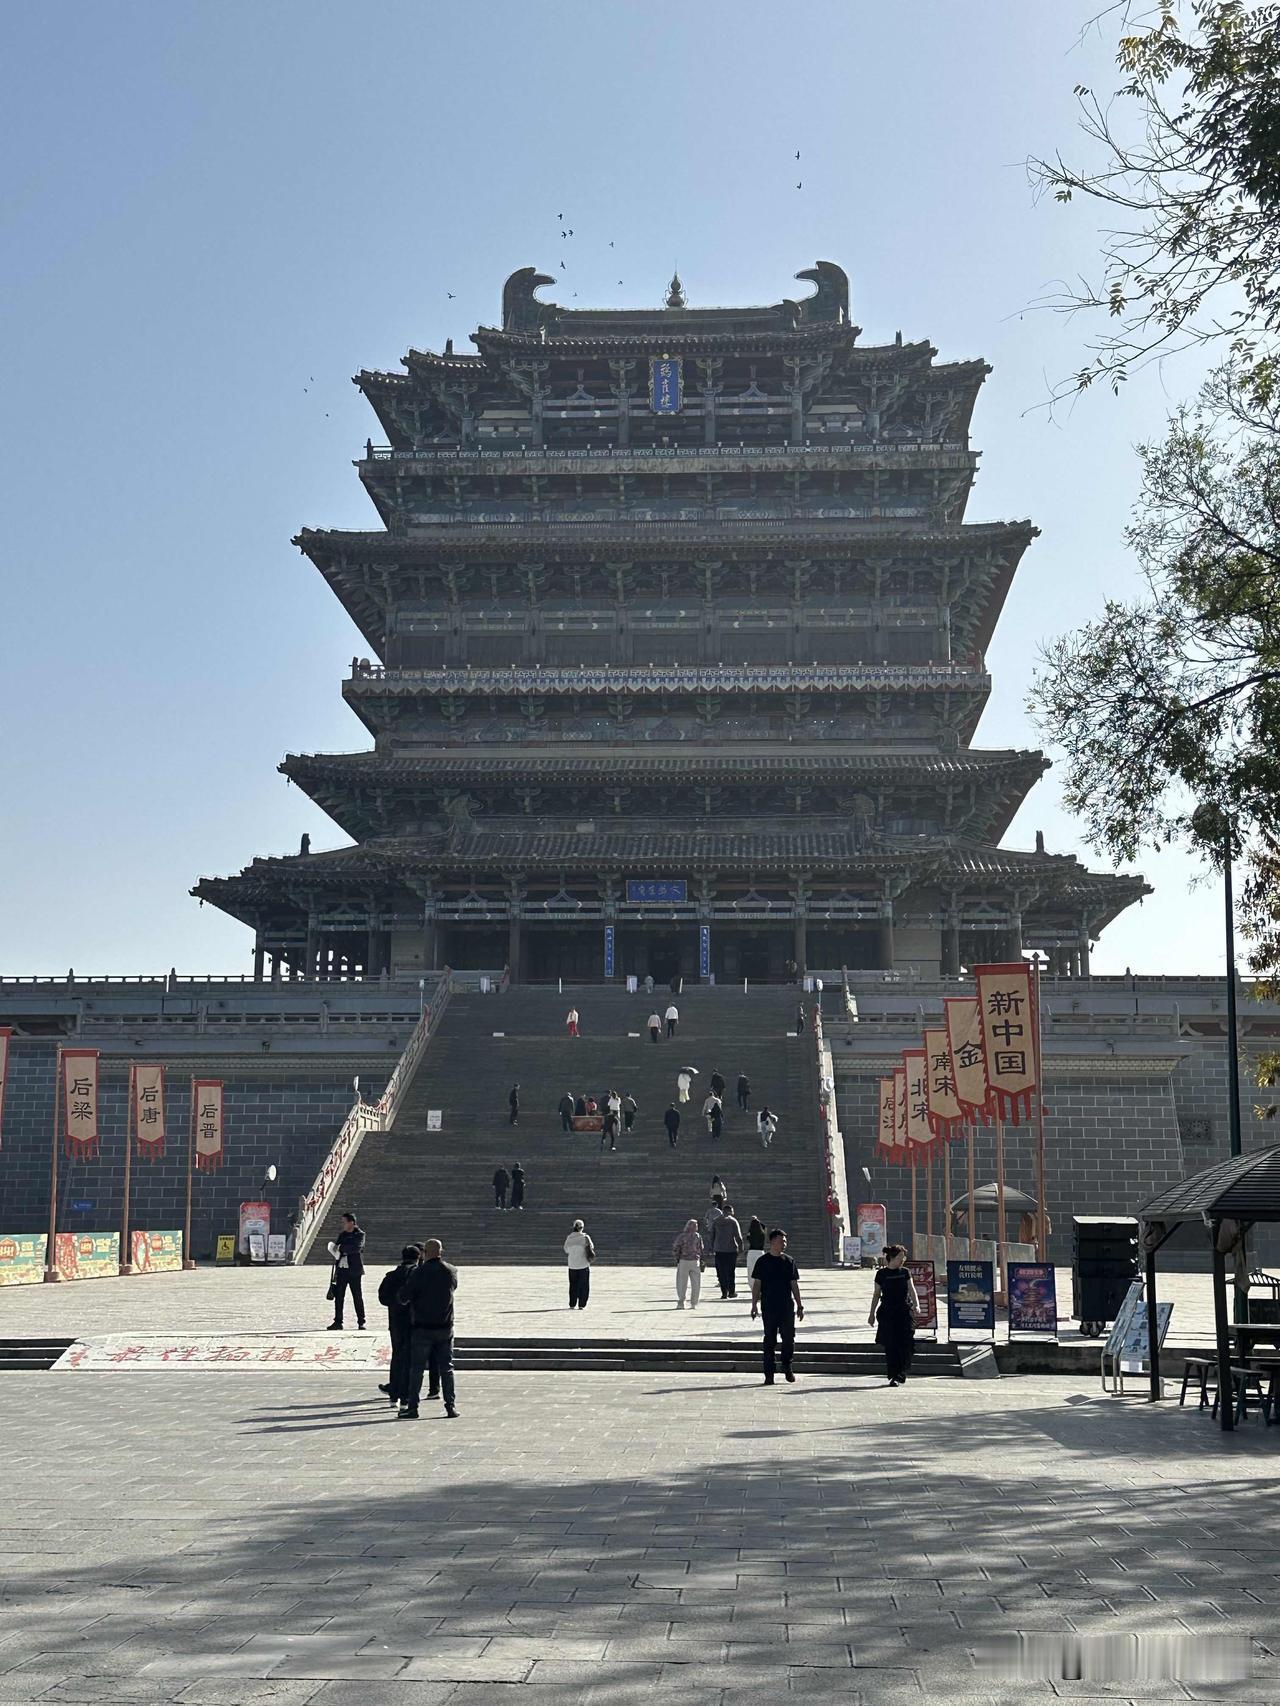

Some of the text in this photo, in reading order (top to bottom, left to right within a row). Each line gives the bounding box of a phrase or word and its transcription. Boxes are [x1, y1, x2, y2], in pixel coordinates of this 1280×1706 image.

[954, 1039, 983, 1069] 金
[988, 990, 1026, 1076] 新中国
[931, 1051, 955, 1097] 南宋
[70, 1077, 93, 1121] 后梁
[140, 1085, 161, 1124] 后唐
[199, 1103, 218, 1139] 后晋
[910, 1078, 929, 1122] 北宋
